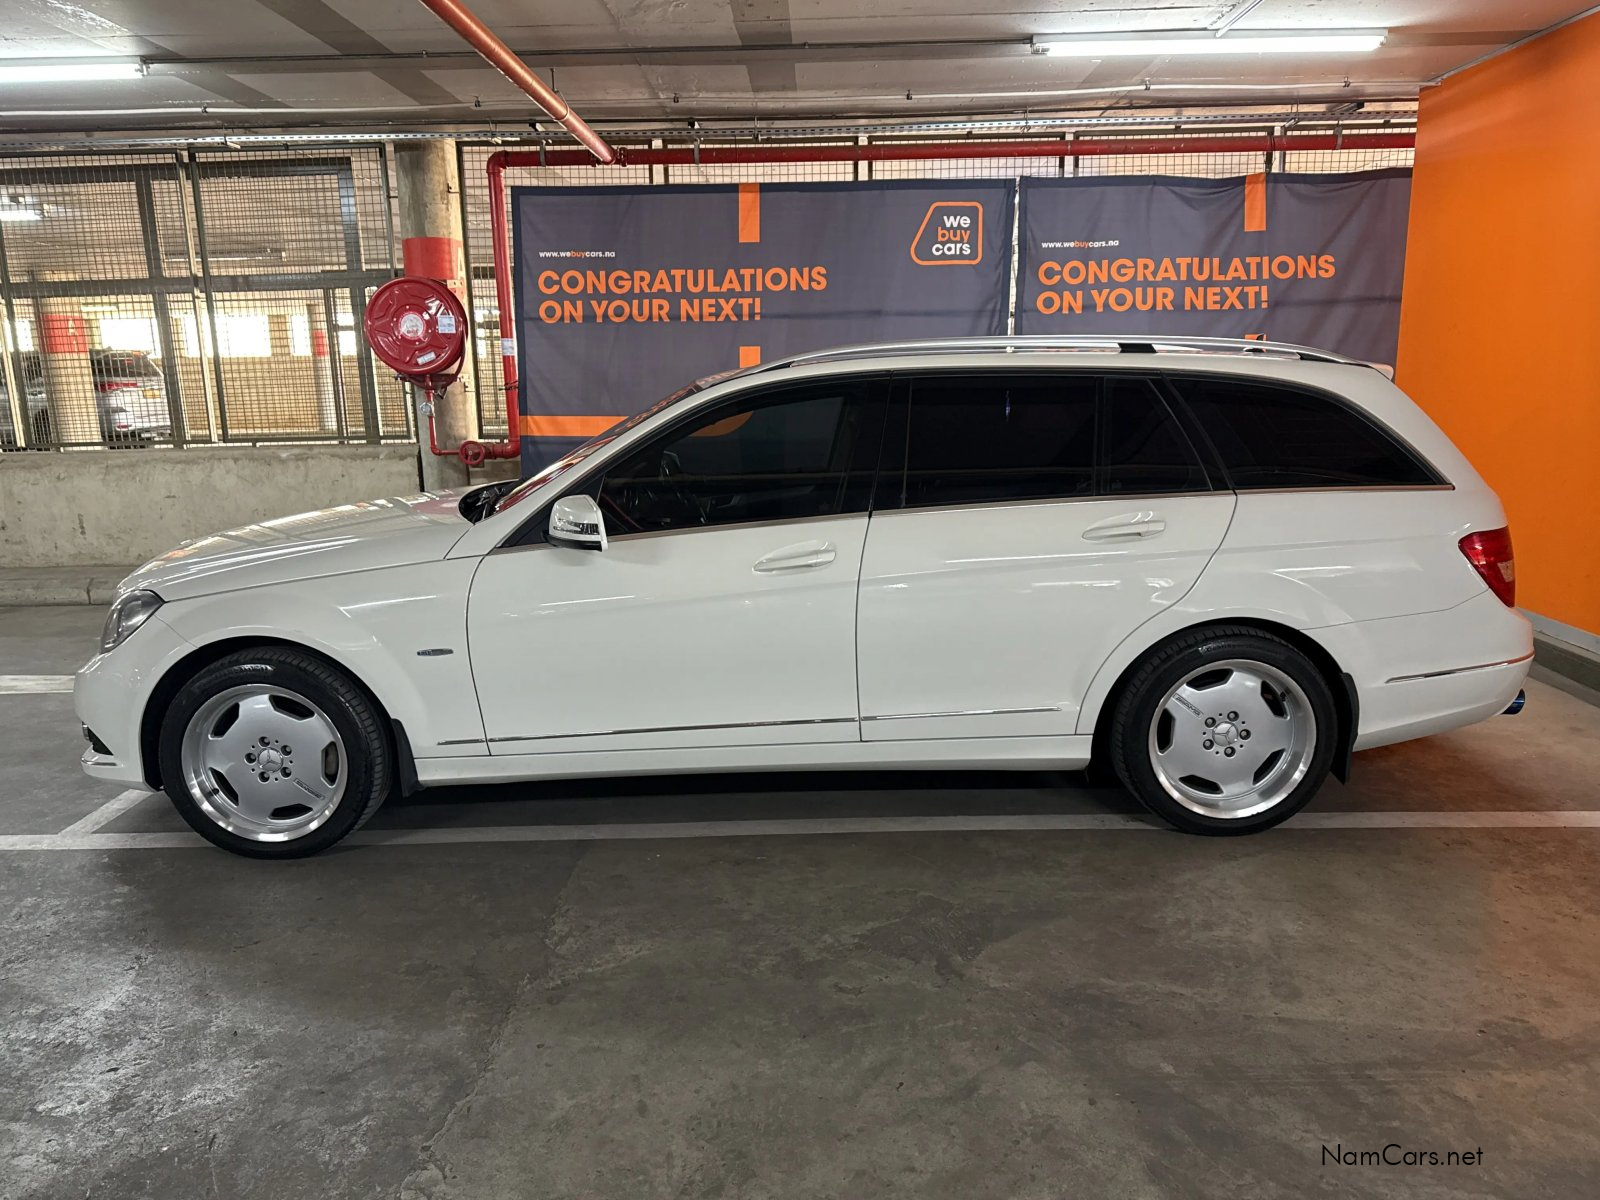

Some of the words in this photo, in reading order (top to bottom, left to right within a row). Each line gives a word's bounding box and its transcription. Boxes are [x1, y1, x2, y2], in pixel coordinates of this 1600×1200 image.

[943, 215, 971, 228] we
[937, 226, 971, 243] buy
[931, 243, 971, 256] cars
[1041, 239, 1120, 249] www.webuycars.na
[538, 250, 616, 259] www.webuycars.na
[1037, 254, 1336, 286] CONGRATULATIONS
[537, 265, 828, 295] CONGRATULATIONS
[1036, 290, 1084, 315] ON
[1090, 286, 1175, 313] YOUR
[1184, 285, 1269, 311] NEXT!
[538, 299, 584, 324] ON
[590, 298, 670, 323] YOUR
[680, 297, 761, 322] NEXT!
